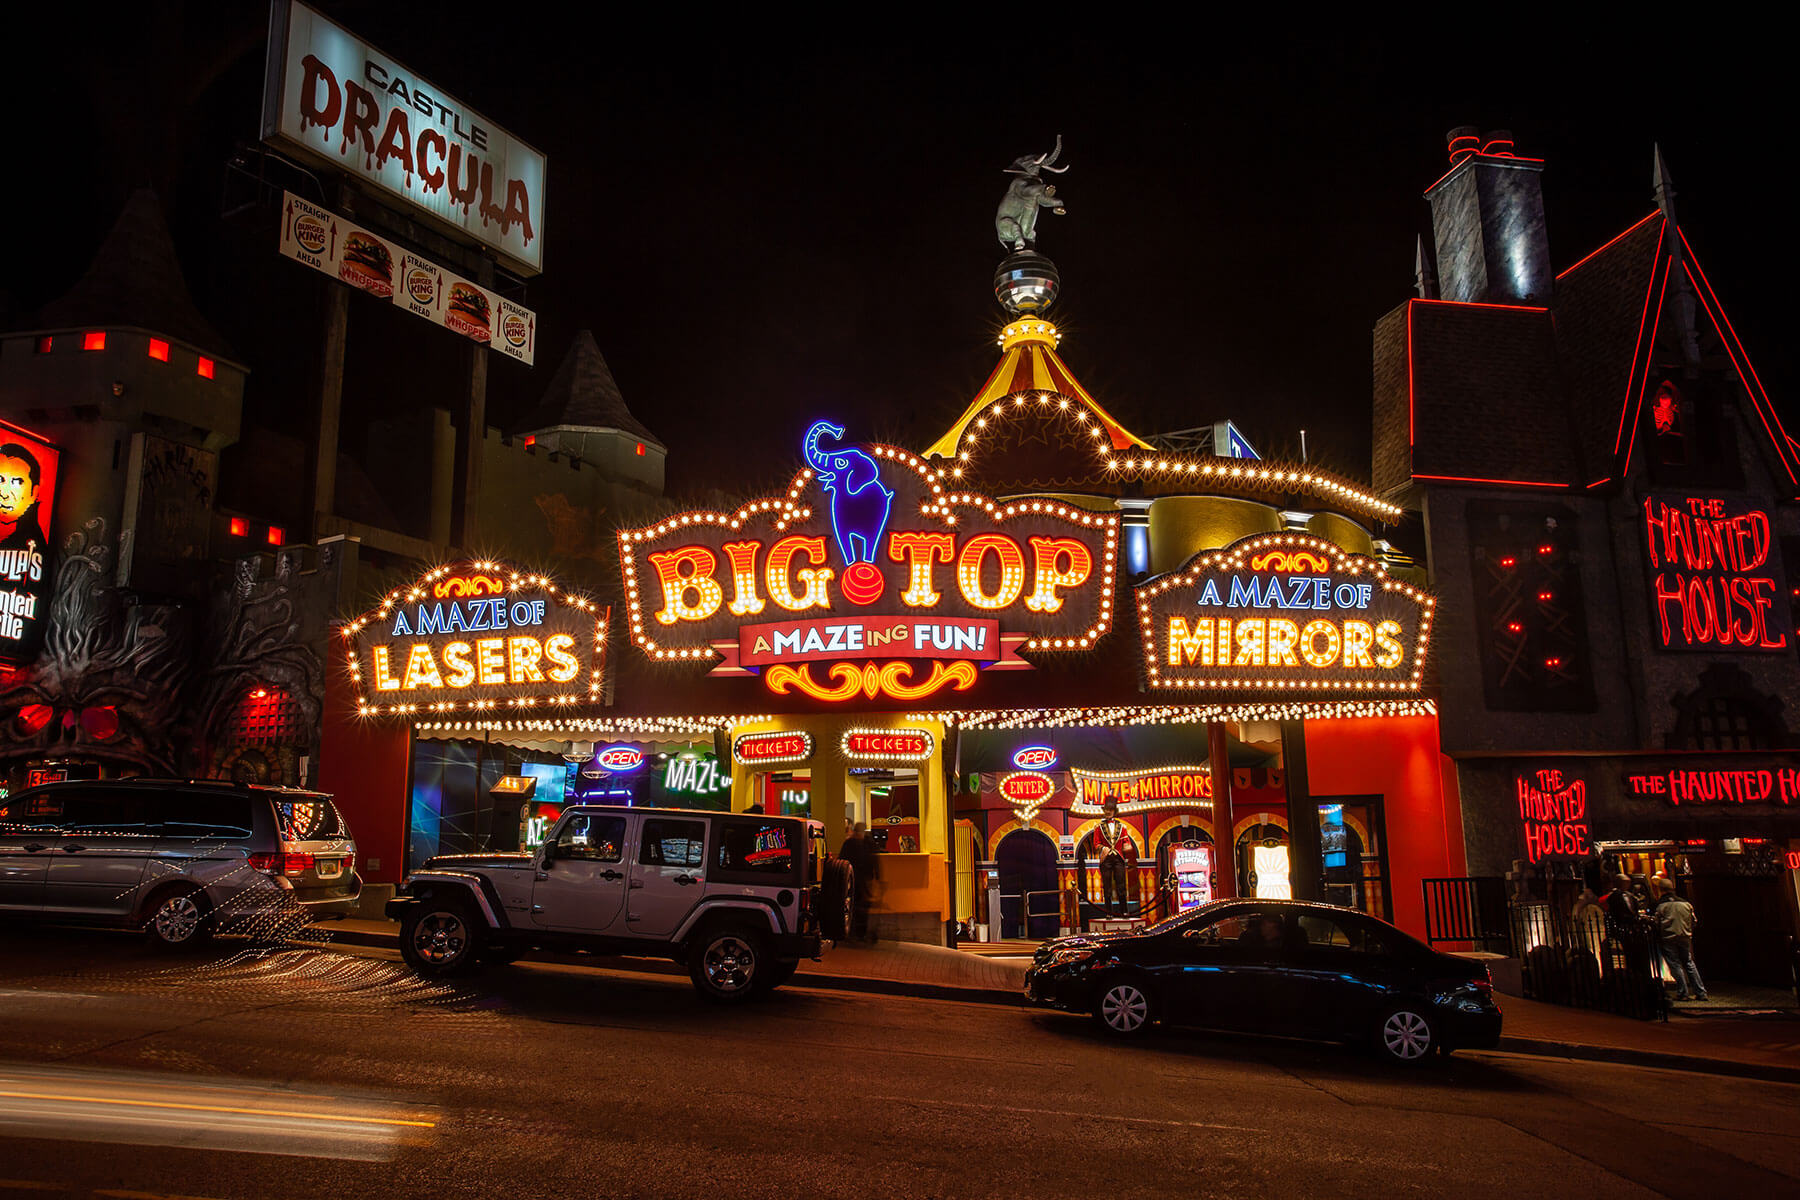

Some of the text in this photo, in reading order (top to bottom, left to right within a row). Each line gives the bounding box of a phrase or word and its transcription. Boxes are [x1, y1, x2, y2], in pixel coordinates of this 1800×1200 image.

[365, 60, 488, 151] CASTLE
[300, 54, 534, 247] DRACULA
[294, 200, 330, 223] STRAIGHT
[297, 222, 325, 234] BURGER
[297, 230, 325, 244] KING
[296, 250, 321, 268] AHEAD
[407, 255, 437, 276] STRAIGHT
[341, 266, 392, 296] WHOPPER
[410, 277, 432, 286] BURGER
[410, 284, 433, 295] KING
[408, 302, 430, 317] AHEAD
[502, 301, 529, 320] STRAIGHT
[447, 315, 490, 340] WHOPPER
[505, 322, 525, 330] BURGER
[505, 327, 526, 338] KING
[504, 345, 523, 359] AHEAD
[1686, 497, 1726, 518] THE
[1644, 496, 1770, 572] HAUNTED
[648, 531, 1094, 625] BIG TOP
[1198, 574, 1373, 610] A MAZE OF
[392, 597, 545, 636] A MAZE OF
[1656, 573, 1787, 648] HOUSE
[913, 624, 987, 652] FUN!
[1167, 616, 1404, 669] MIRRORS
[373, 634, 580, 692] LASERS
[743, 739, 799, 756] TICKETS
[855, 737, 923, 752] TICKETS
[600, 752, 643, 765] OPEN
[1017, 750, 1056, 765] OPEN
[665, 758, 719, 794] MAZE
[1010, 780, 1045, 795] ENTER
[1138, 774, 1213, 801] MIRRORS
[1536, 769, 1565, 792] THE
[1629, 775, 1666, 794] THE
[1668, 769, 1773, 805] HAUNTED
[1517, 774, 1586, 822] HAUNTED
[1525, 821, 1590, 864] HOUSE
